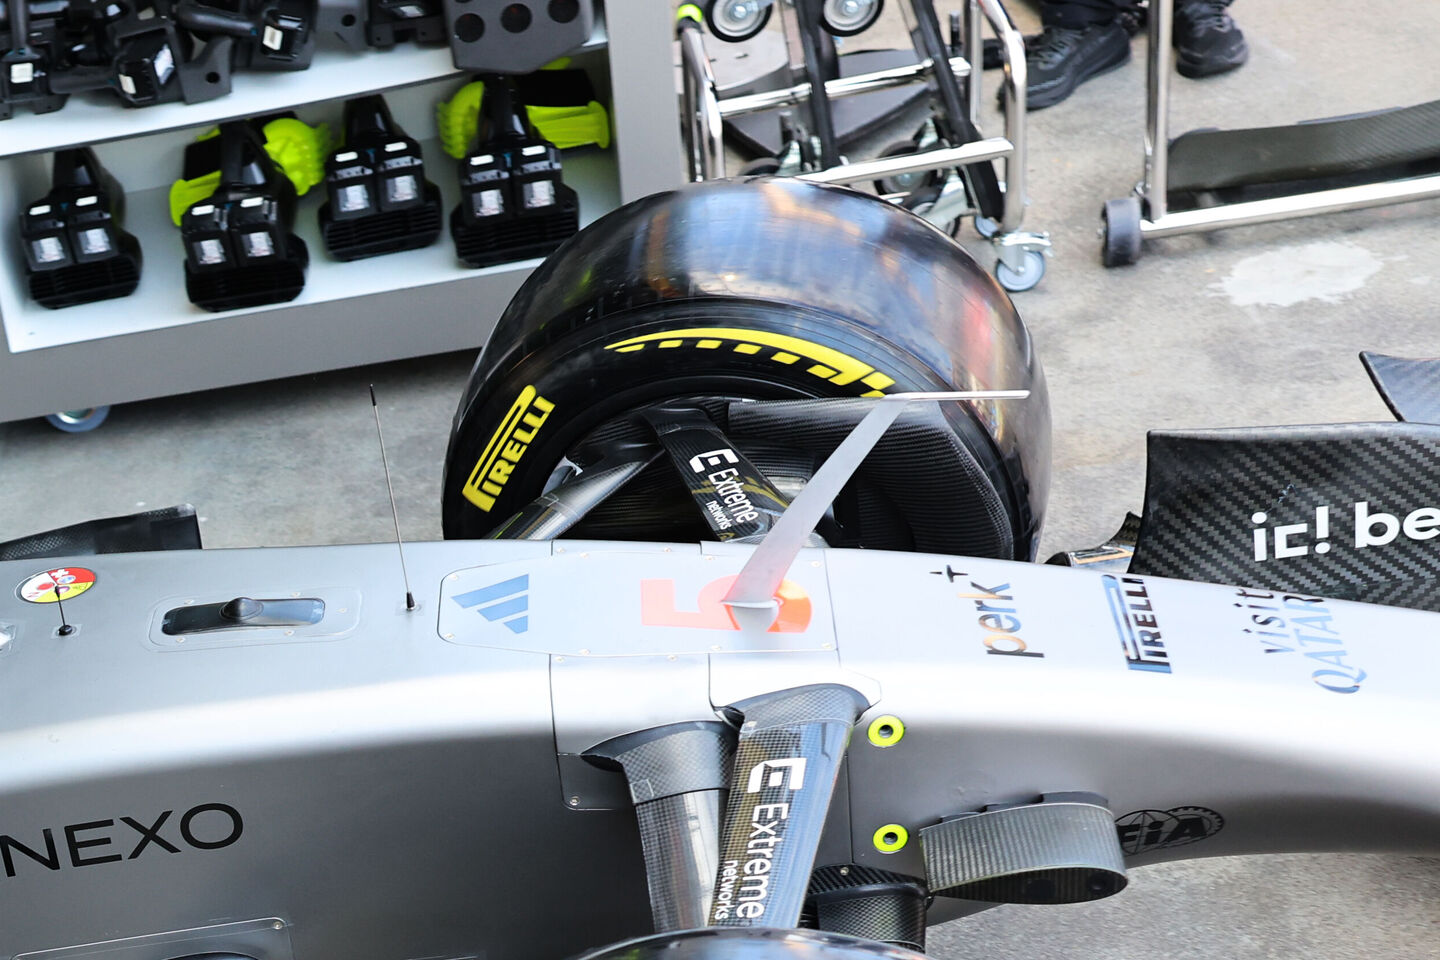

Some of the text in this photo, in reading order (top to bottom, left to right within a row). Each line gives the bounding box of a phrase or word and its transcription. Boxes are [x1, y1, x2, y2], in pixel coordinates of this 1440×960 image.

[462, 384, 556, 513] PIRELLI
[705, 500, 733, 530] networks
[708, 467, 759, 523] Extreme
[1101, 574, 1173, 674] PIRELLI
[1233, 588, 1296, 654] visit
[1282, 595, 1368, 694] QATAR
[714, 859, 739, 920] networks
[736, 802, 790, 919] Extreme
